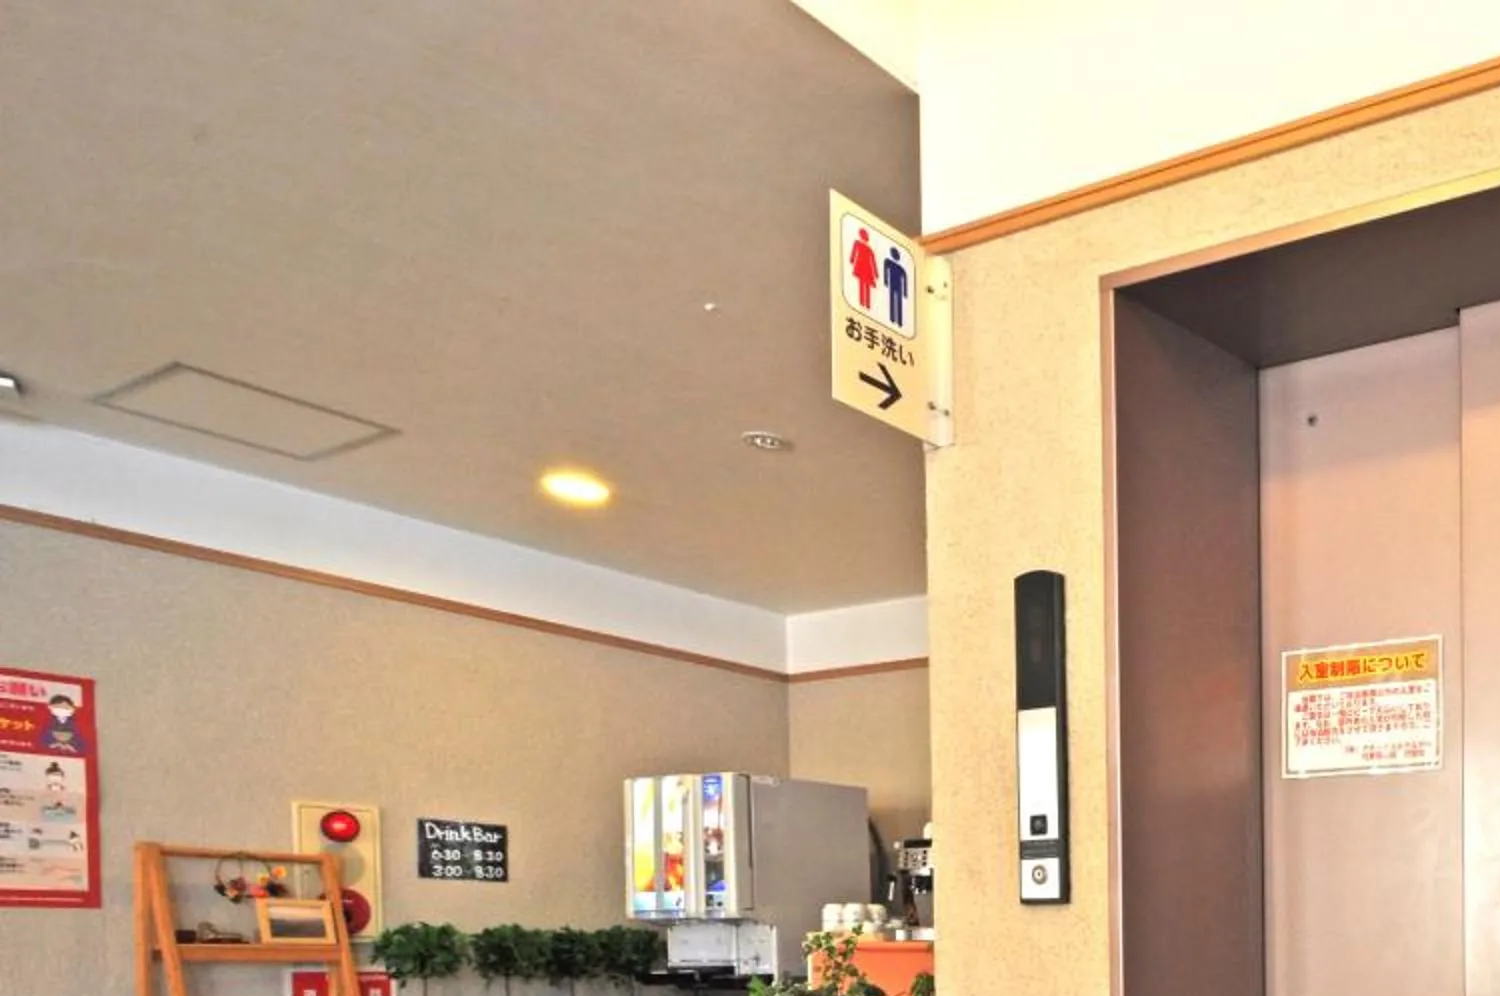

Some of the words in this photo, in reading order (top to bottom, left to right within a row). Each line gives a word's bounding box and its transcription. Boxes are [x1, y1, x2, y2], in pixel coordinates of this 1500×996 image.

[845, 317, 915, 367] お手洗い
[425, 822, 472, 841] Drink
[473, 826, 503, 843] Bar
